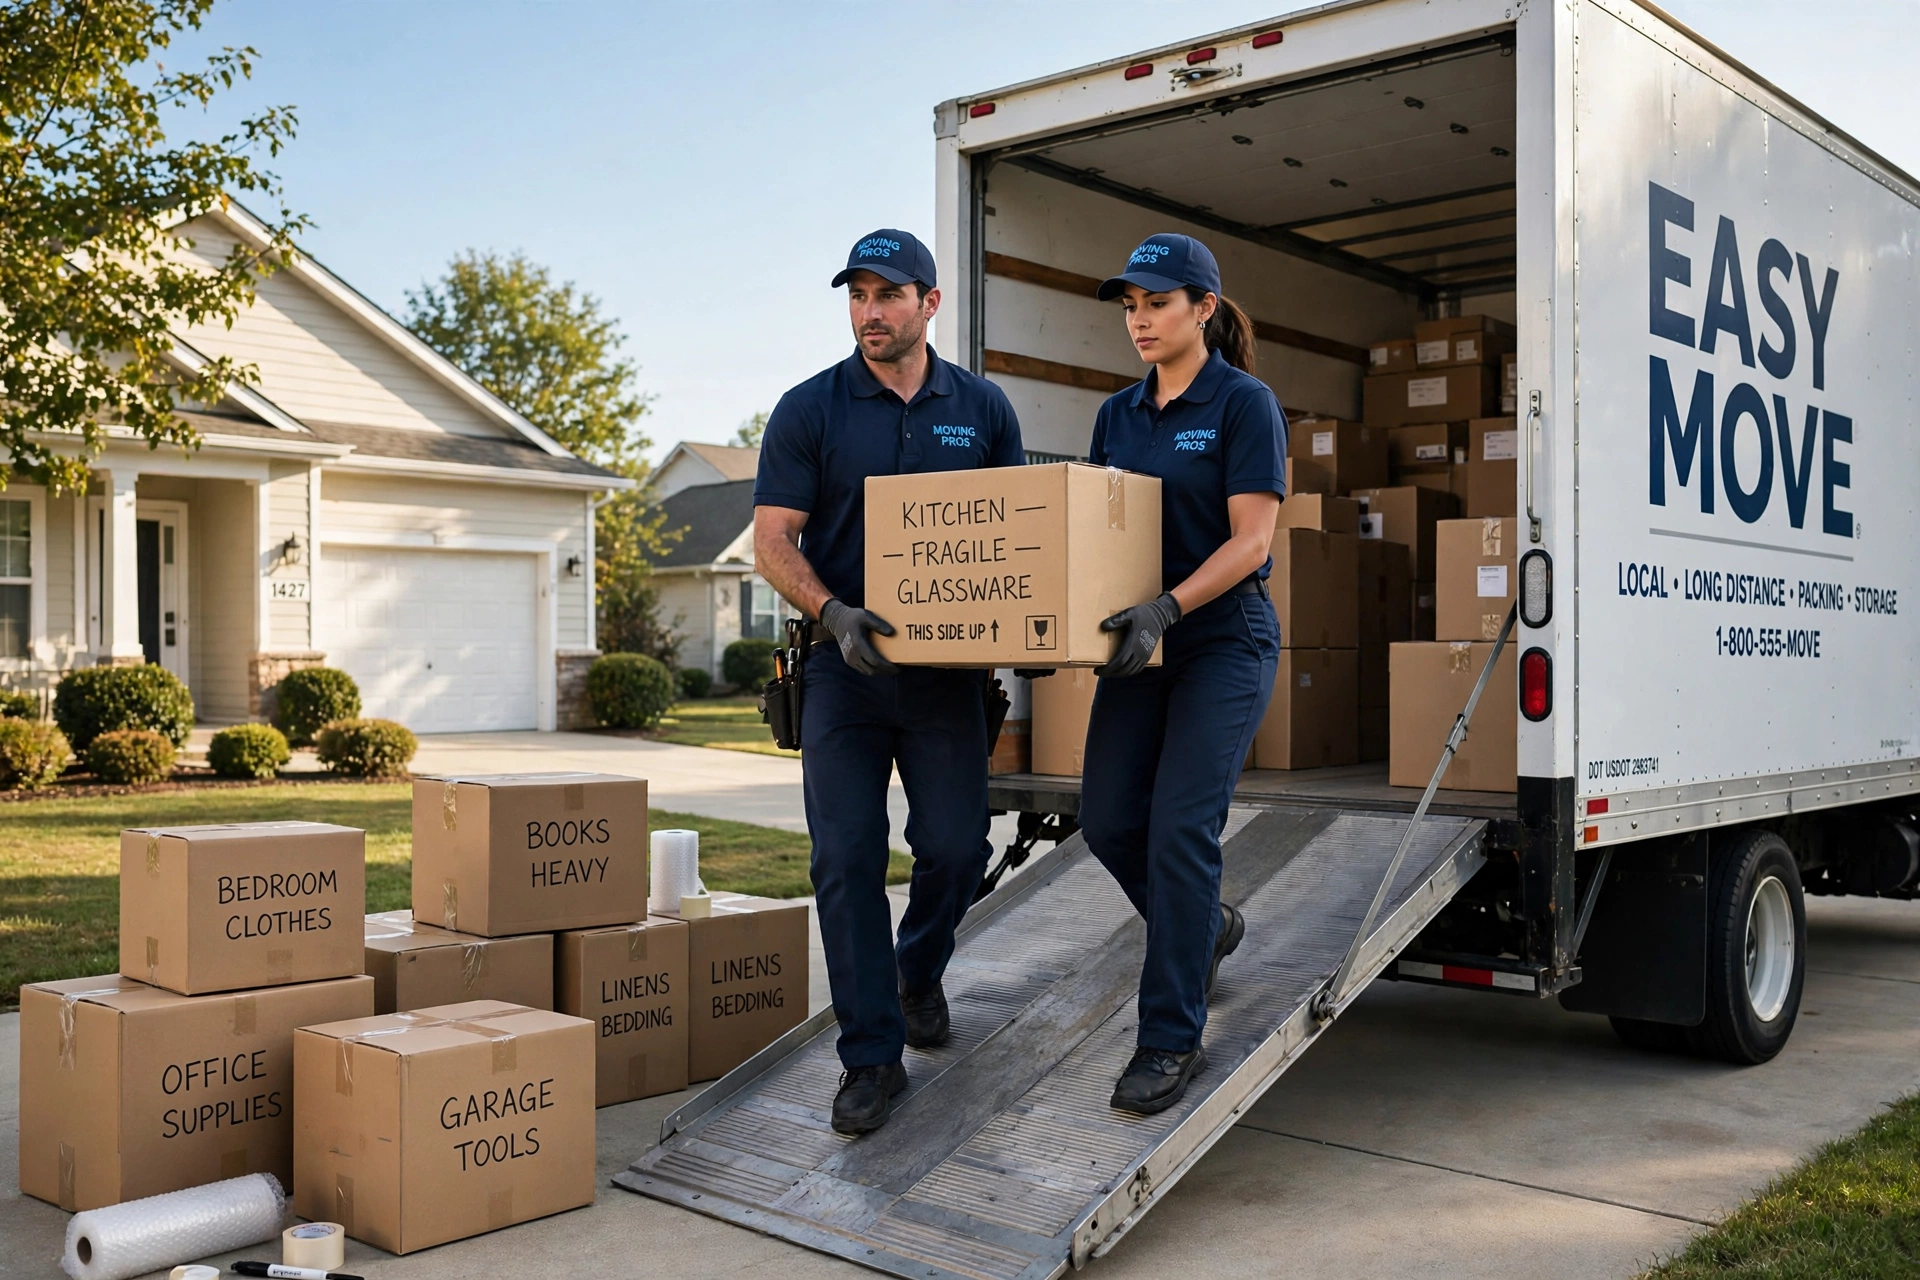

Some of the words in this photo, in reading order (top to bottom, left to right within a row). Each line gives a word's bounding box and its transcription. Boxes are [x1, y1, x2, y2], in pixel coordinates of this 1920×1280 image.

[857, 237, 900, 251] MOVING
[859, 246, 891, 258] PROS
[1128, 253, 1158, 266] PROS
[1648, 180, 1839, 391] EASY
[932, 425, 976, 437] MOVING
[941, 435, 971, 448] PROS
[1173, 429, 1217, 441] MOVING
[1174, 440, 1206, 451] PROS
[1649, 354, 1853, 538] MOVE
[902, 497, 1005, 529] KITCHEN
[911, 537, 1007, 567] FRAGILE
[272, 582, 305, 598] 1427
[897, 574, 1033, 605] GLASSWARE
[1618, 561, 1668, 599] LOCAL
[1684, 568, 1723, 602] LONG
[1726, 572, 1786, 607] DISTANCE
[1798, 580, 1844, 611] PACKING
[1854, 586, 1898, 615] STORAGE
[905, 623, 934, 641] THIS
[937, 623, 965, 641] SIDE
[969, 623, 986, 640] UP
[1715, 625, 1821, 658] 1-800-555-MOVE
[1588, 760, 1604, 780] DOT
[1605, 758, 1631, 778] USDOT
[526, 818, 610, 850] BOOKS
[217, 869, 338, 904] BEDROOM
[531, 856, 610, 888] HEAVY
[225, 907, 332, 940] CLOTHES
[711, 953, 782, 985] LINENS
[601, 972, 670, 1004] LINENS
[711, 987, 784, 1019] BEDDING
[601, 1005, 673, 1038] BEDDING
[161, 1049, 268, 1095] OFFICE
[162, 1091, 283, 1139] SUPPLIES
[440, 1078, 554, 1130] GARAGE
[454, 1127, 541, 1172] TOOLS
